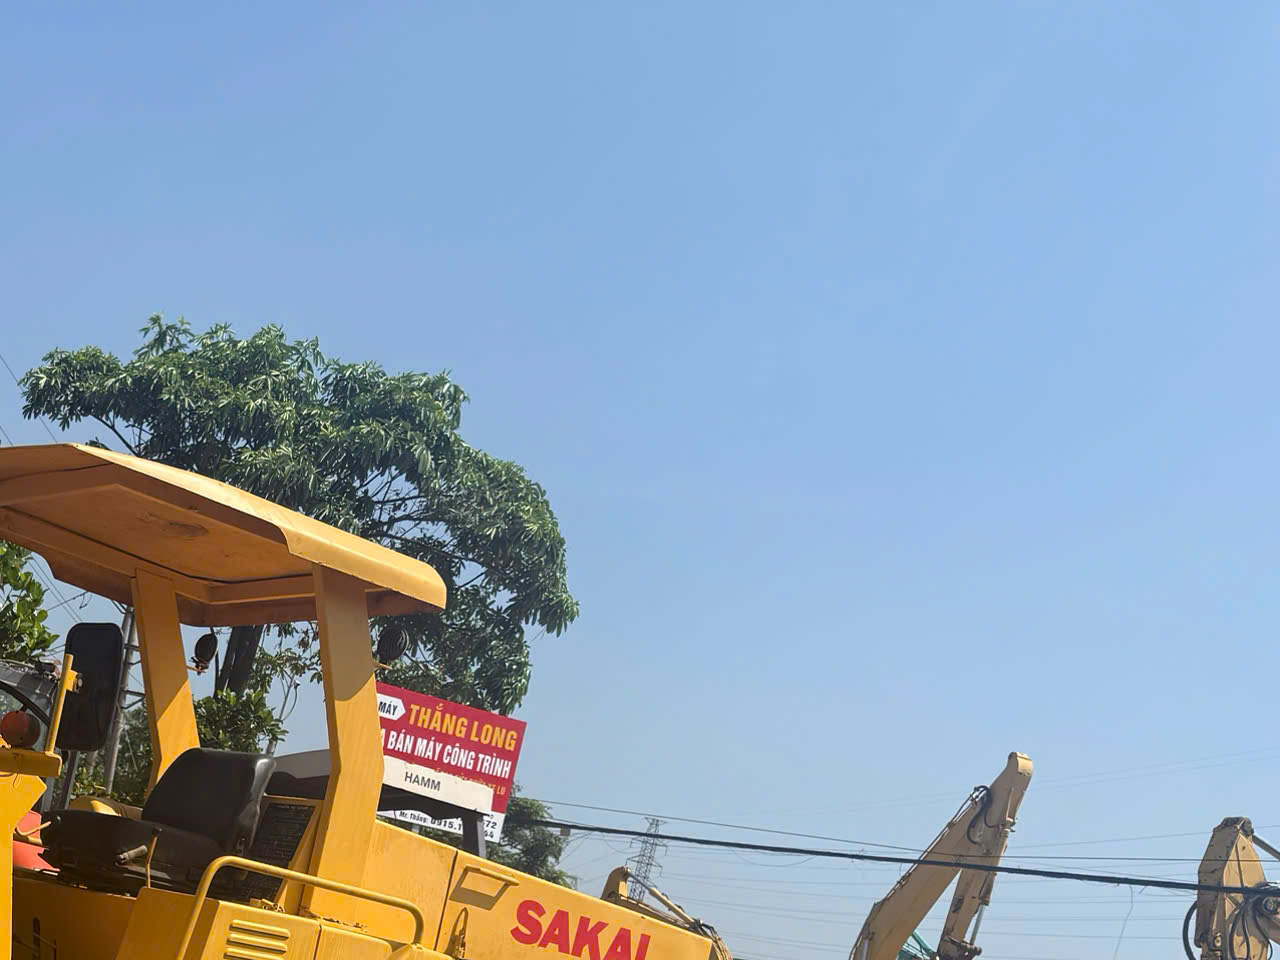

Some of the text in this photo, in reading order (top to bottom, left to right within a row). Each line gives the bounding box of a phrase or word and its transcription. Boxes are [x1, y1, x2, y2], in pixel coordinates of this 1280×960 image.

[378, 700, 398, 716] MÁY
[408, 703, 519, 752] THẮNG LONG
[387, 729, 415, 754] BÁN
[414, 737, 443, 761] MÁY
[442, 744, 476, 771] CÔNG
[476, 752, 513, 780] TRÌNH
[404, 771, 441, 791] HAMM
